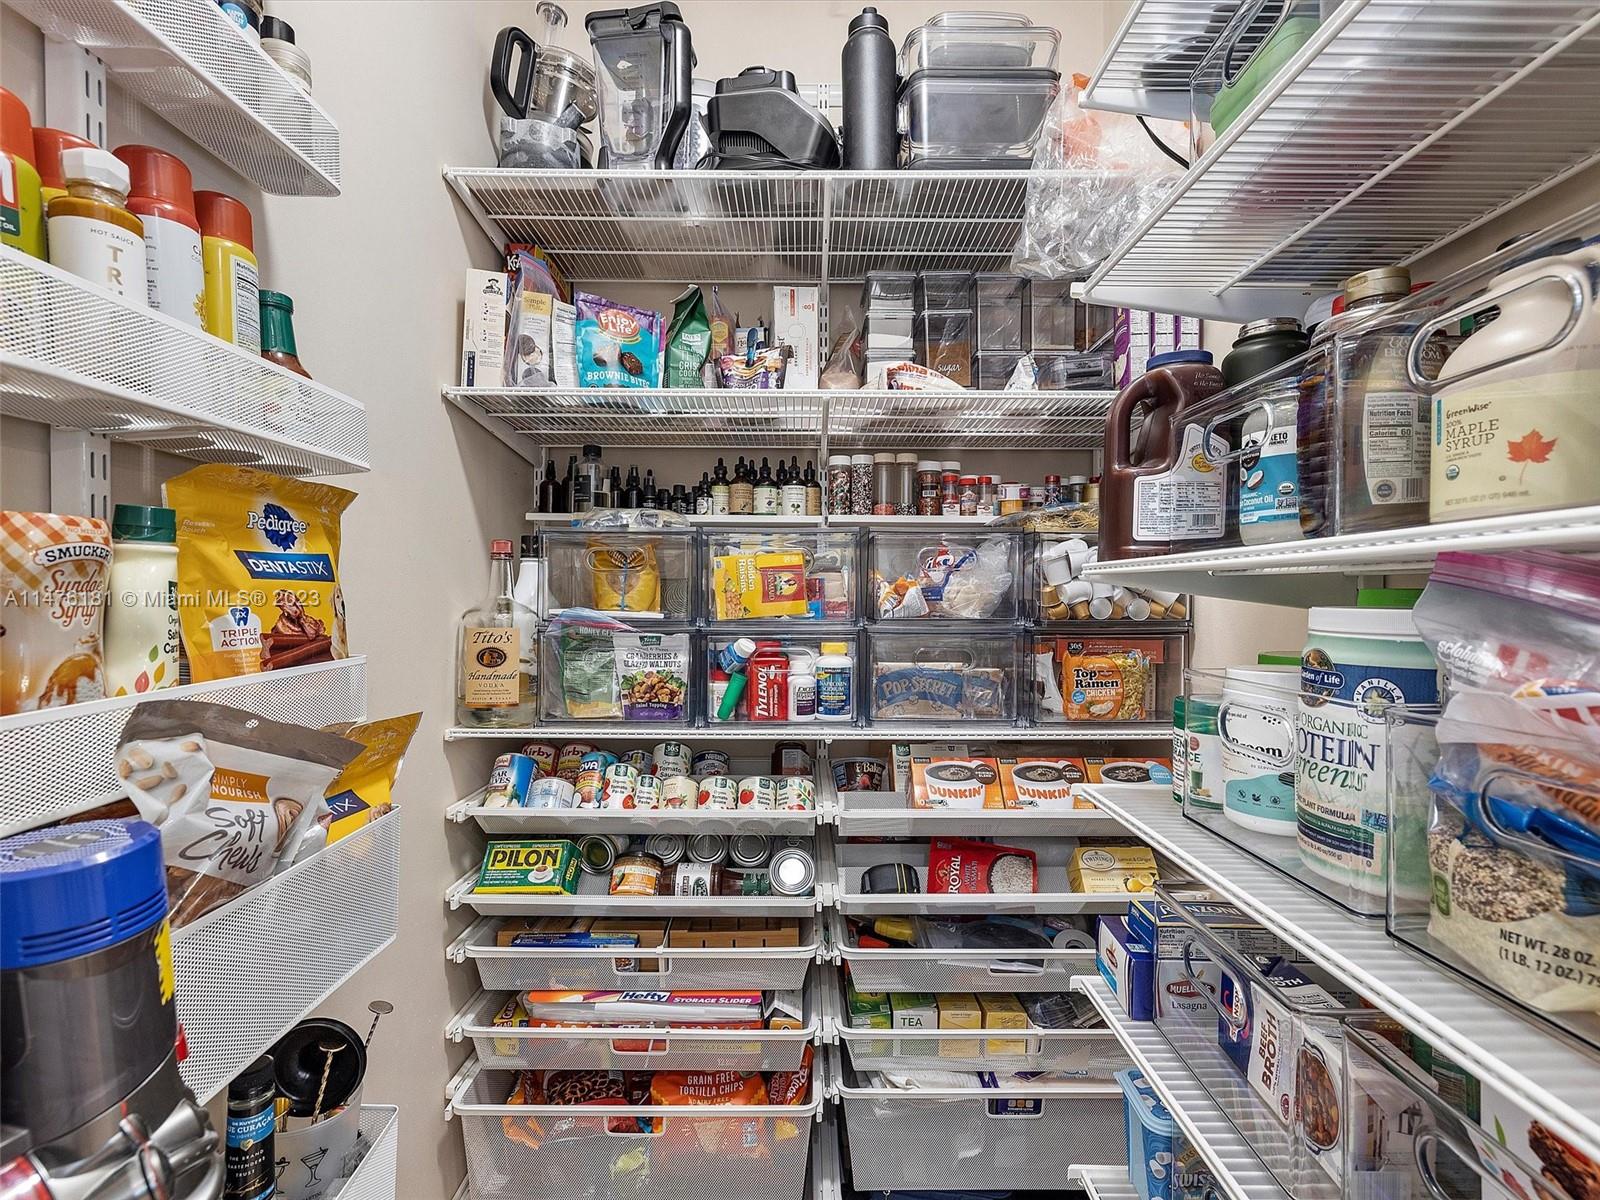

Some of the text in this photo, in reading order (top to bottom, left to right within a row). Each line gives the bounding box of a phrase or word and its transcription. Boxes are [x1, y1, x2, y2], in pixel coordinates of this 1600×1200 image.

[90, 227, 135, 246] HOT SAUCE
[599, 312, 637, 329] Enjoy
[609, 322, 632, 334] Life
[937, 363, 962, 376] sugar
[586, 371, 650, 388] BROWNIE BITES
[1369, 409, 1412, 418] Nutrition Facts
[1446, 402, 1489, 420] GreenWise
[1446, 418, 1463, 428] 100%
[1446, 418, 1500, 441] MAPLE
[1369, 428, 1411, 437] Calories 60
[1445, 432, 1496, 453] SYRUP
[1243, 495, 1274, 507] Coconut Oil
[246, 511, 308, 535] Pedigree
[247, 558, 328, 577] DENTASTIX
[45, 568, 104, 593] Sundae
[738, 559, 747, 593] Raisins
[52, 595, 96, 627] Syrup
[220, 627, 259, 638] TRIPLE
[472, 631, 513, 645] Tito's
[220, 636, 259, 649] ACTION
[1068, 642, 1083, 650] 365
[648, 659, 682, 669] WALNUTS
[468, 671, 518, 682] Handmade
[1073, 668, 1098, 681] Top
[1324, 672, 1341, 685] Life
[1075, 678, 1120, 689] Ramen
[1355, 679, 1403, 701] VANILLA
[755, 665, 769, 718] TYLENOL
[1086, 688, 1116, 697] CHICKEN
[665, 744, 680, 753] 365
[579, 761, 598, 771] OYA
[658, 765, 682, 774] Tomato
[212, 774, 248, 787] SIMPLY
[211, 784, 263, 800] NOURISH
[928, 784, 984, 799] DUNKIN'
[1017, 784, 1073, 800] DUNKIN'
[1006, 799, 1015, 807] 10
[204, 806, 270, 843] Soft
[178, 829, 264, 874] Chews
[490, 849, 560, 868] PILON
[947, 855, 962, 894] ROYAL
[1499, 929, 1598, 968] NET WT. 28 OZ.
[1499, 946, 1585, 986] (1 LB. 12 OZ.)
[622, 991, 667, 1003] Hefty
[672, 996, 753, 1005] STORAGE SLIDER
[1171, 1001, 1208, 1012] Lasagna
[900, 1017, 924, 1027] TEA
[1258, 1022, 1270, 1060] BEEF
[1261, 1009, 1277, 1092] BROTH
[687, 1070, 736, 1086] GRAIN FREE
[679, 1080, 745, 1097] TORTILLA CHIPS
[241, 1149, 265, 1161] BRAND
[227, 1156, 266, 1170] BARTENDERS
[235, 1169, 256, 1178] TRUST
